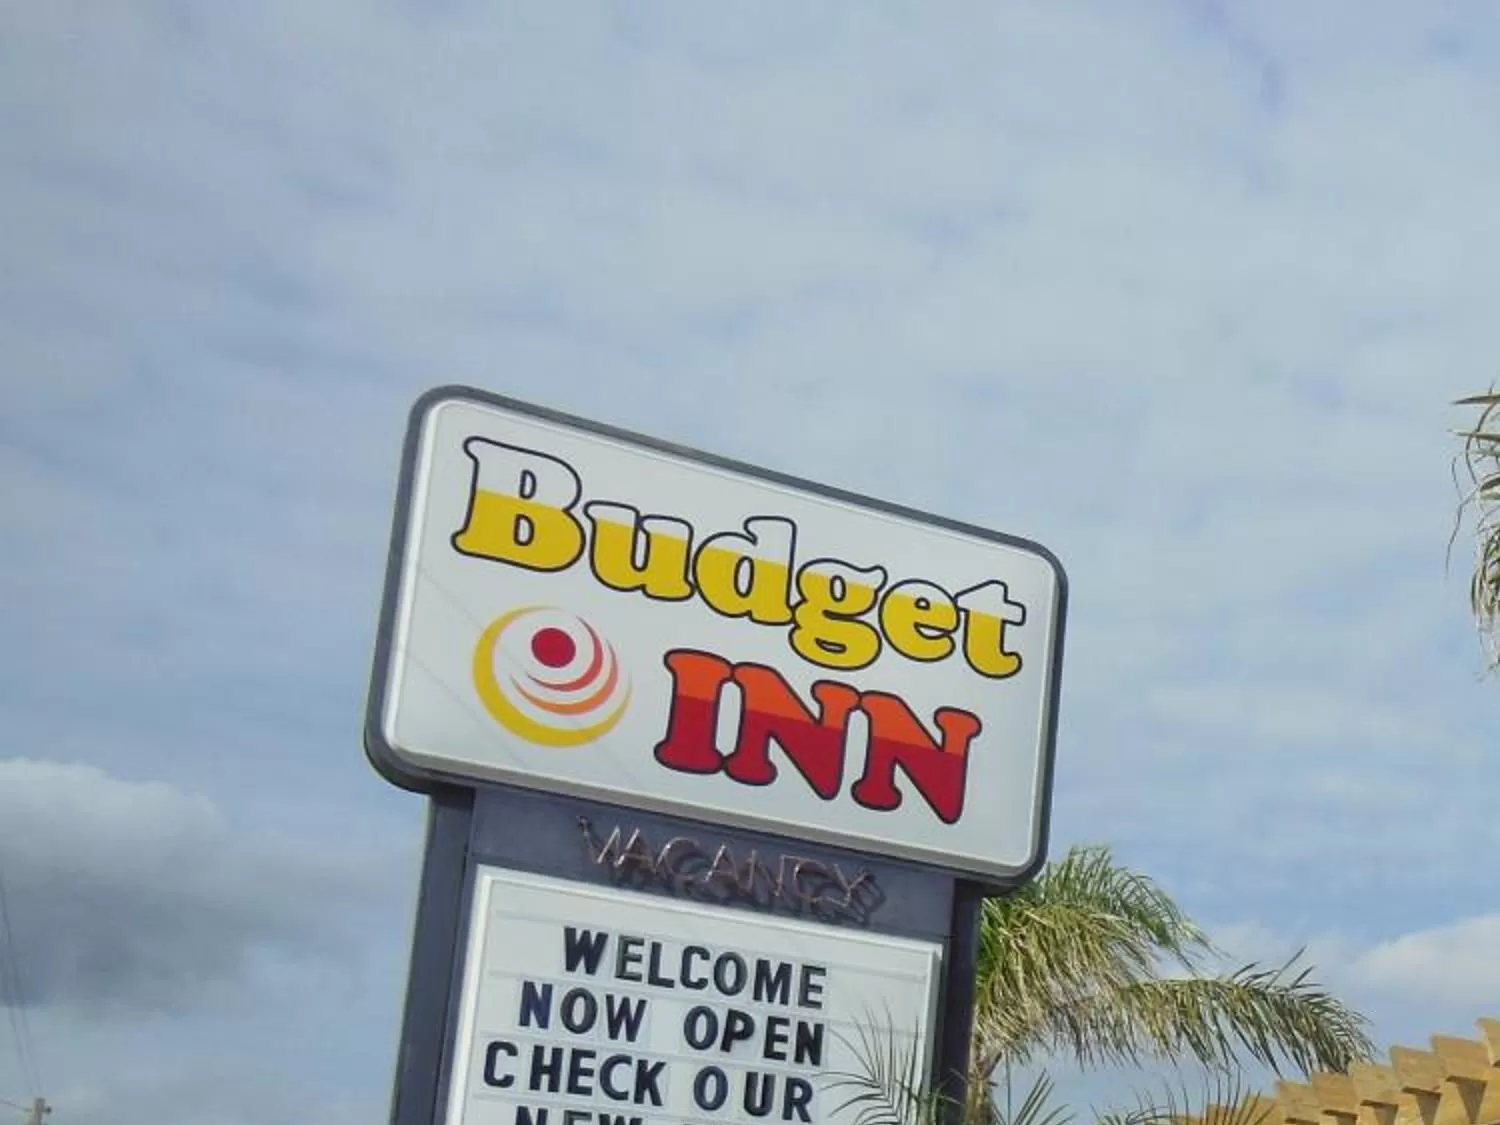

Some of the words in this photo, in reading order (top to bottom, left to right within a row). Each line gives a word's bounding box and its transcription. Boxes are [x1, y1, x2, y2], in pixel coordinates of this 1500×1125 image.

[451, 436, 1026, 679] Budget
[654, 648, 982, 824] INN
[576, 815, 876, 907] VACANCY
[563, 926, 828, 1010] WELCOME
[518, 980, 647, 1042] NOW
[683, 1005, 825, 1067] OPEN
[483, 1041, 667, 1107] CHECK
[693, 1065, 813, 1123] OUR
